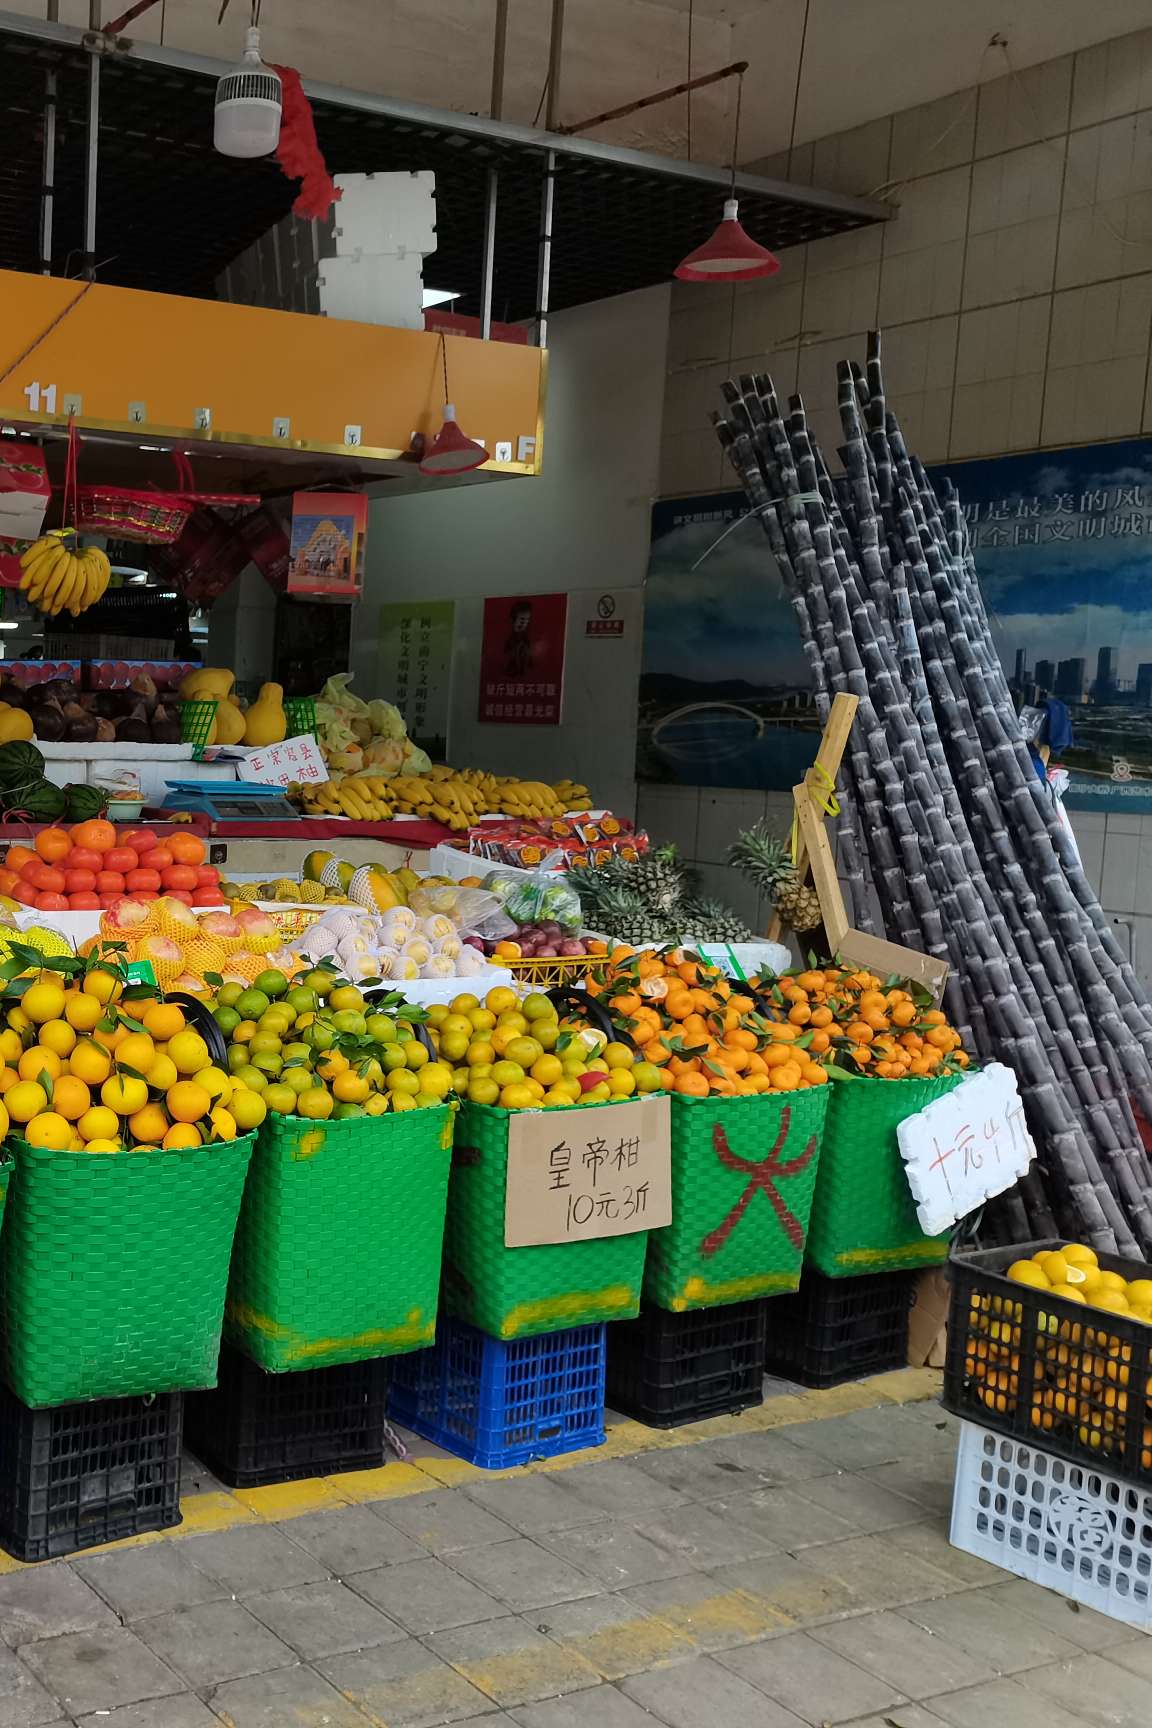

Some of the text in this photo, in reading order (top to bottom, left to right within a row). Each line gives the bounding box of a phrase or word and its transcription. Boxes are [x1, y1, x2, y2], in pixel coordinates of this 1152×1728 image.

[24, 381, 57, 414] 11
[517, 435, 536, 461] F
[962, 486, 1152, 523] 明是最美的风
[968, 513, 1152, 548] 全国文明城
[548, 1136, 640, 1190] 皇帝柑
